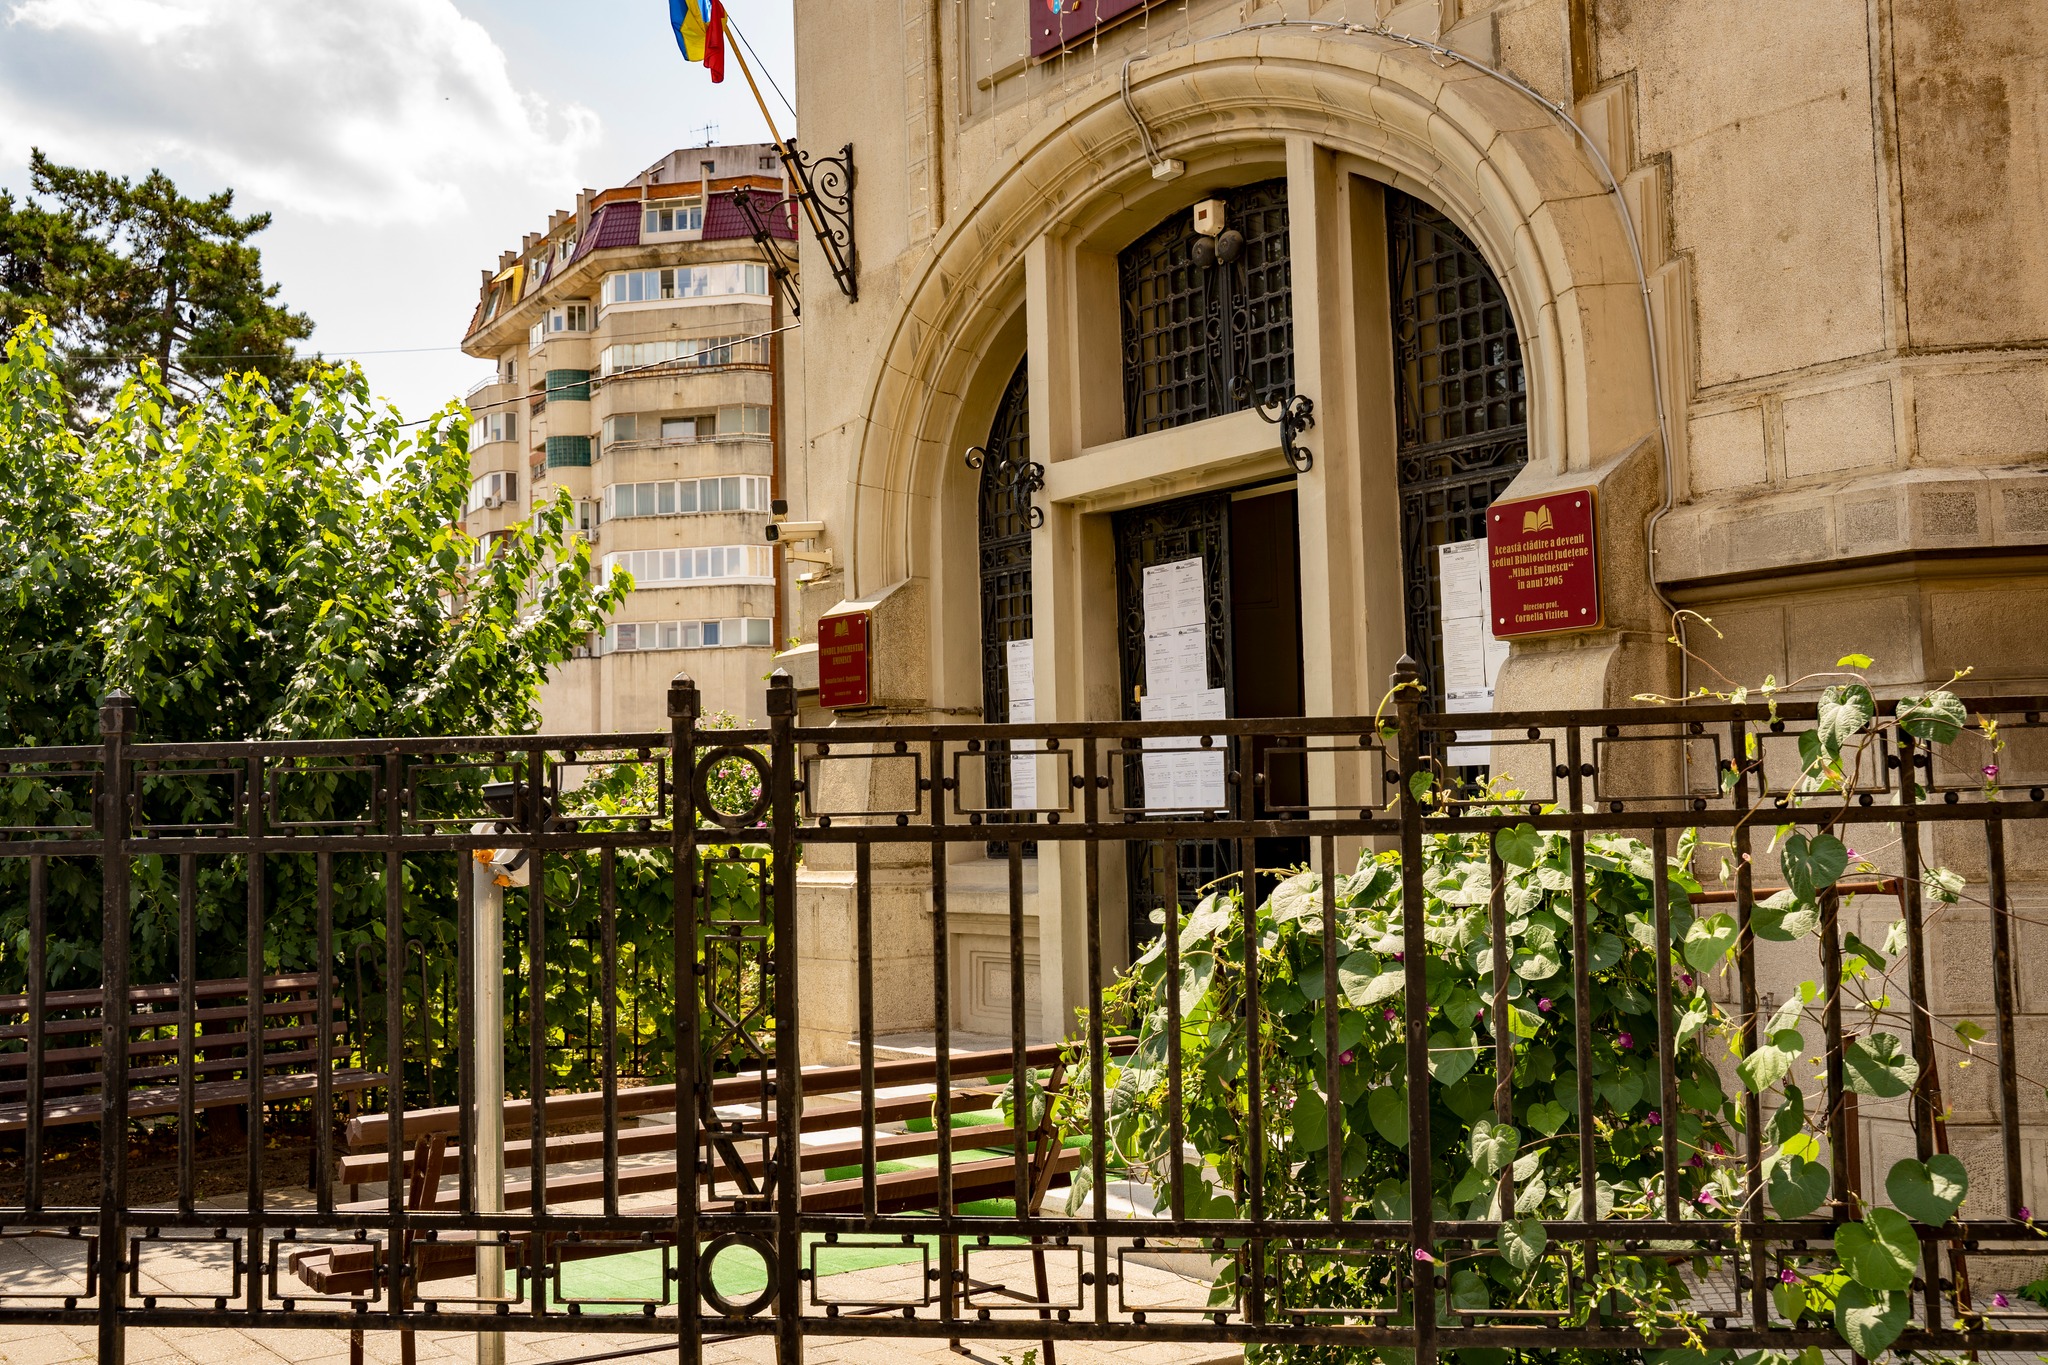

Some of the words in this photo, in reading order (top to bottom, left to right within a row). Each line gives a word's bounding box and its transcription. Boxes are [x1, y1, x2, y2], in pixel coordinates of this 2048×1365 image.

[1494, 542, 1522, 555] Această
[1523, 538, 1549, 551] clădire
[1556, 534, 1585, 546] devenit
[1491, 555, 1514, 568] sediul
[1514, 551, 1554, 565] Bibliotecii
[1554, 547, 1589, 560] Județene
[1517, 579, 1525, 590] în
[1526, 577, 1543, 589] anul
[1544, 575, 1563, 587] 2005
[1523, 601, 1545, 612] Director
[1546, 600, 1560, 610] prof.
[1515, 612, 1544, 623] Cornelia
[1544, 609, 1569, 620] Viziteu
